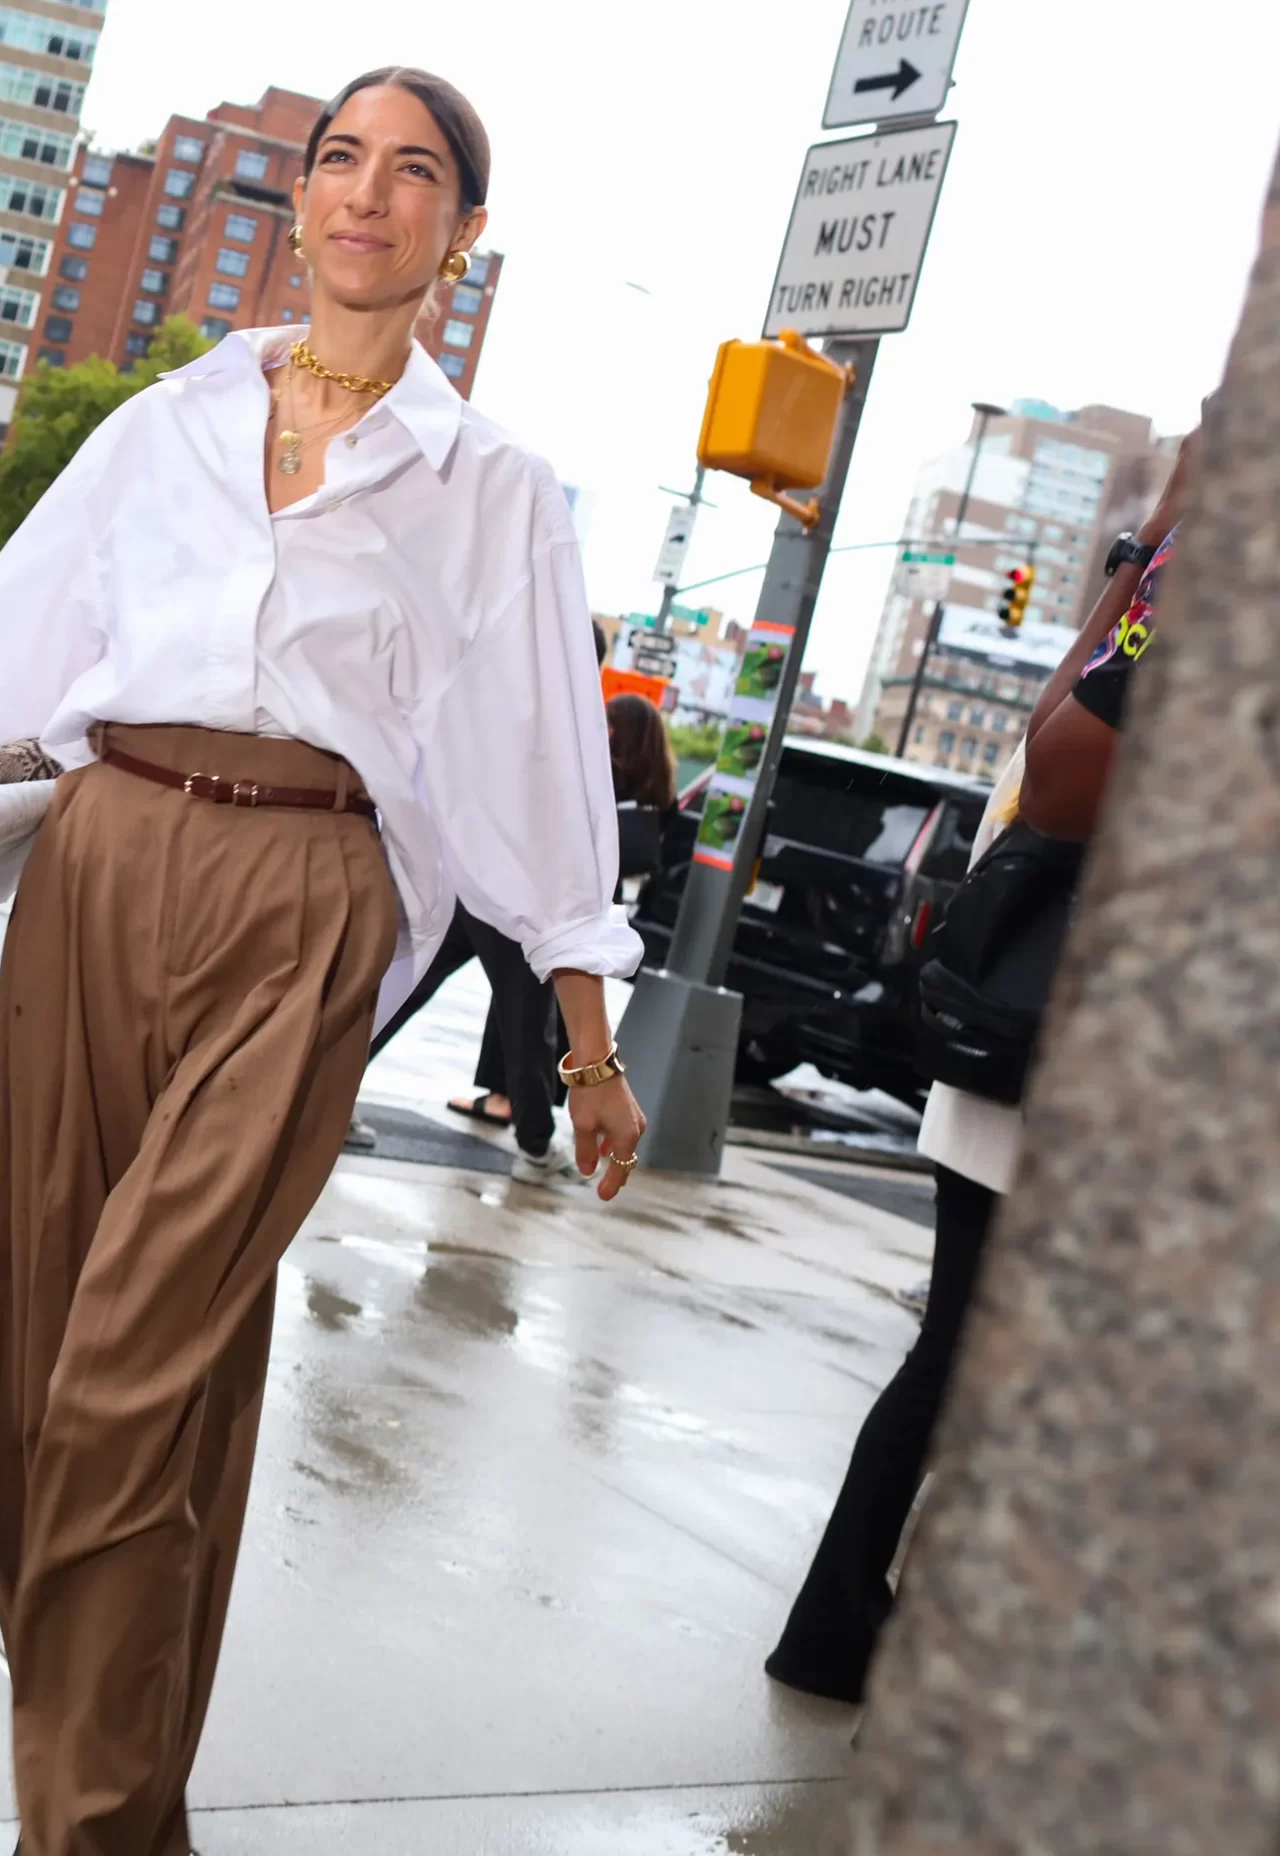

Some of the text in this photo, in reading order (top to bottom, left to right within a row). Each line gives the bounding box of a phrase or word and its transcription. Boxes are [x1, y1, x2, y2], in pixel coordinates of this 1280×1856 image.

[858, 4, 946, 48] ROUTE
[802, 149, 941, 199] RIGHT LANE
[814, 211, 896, 257] MUST
[776, 273, 911, 314] TURN RIGHT
